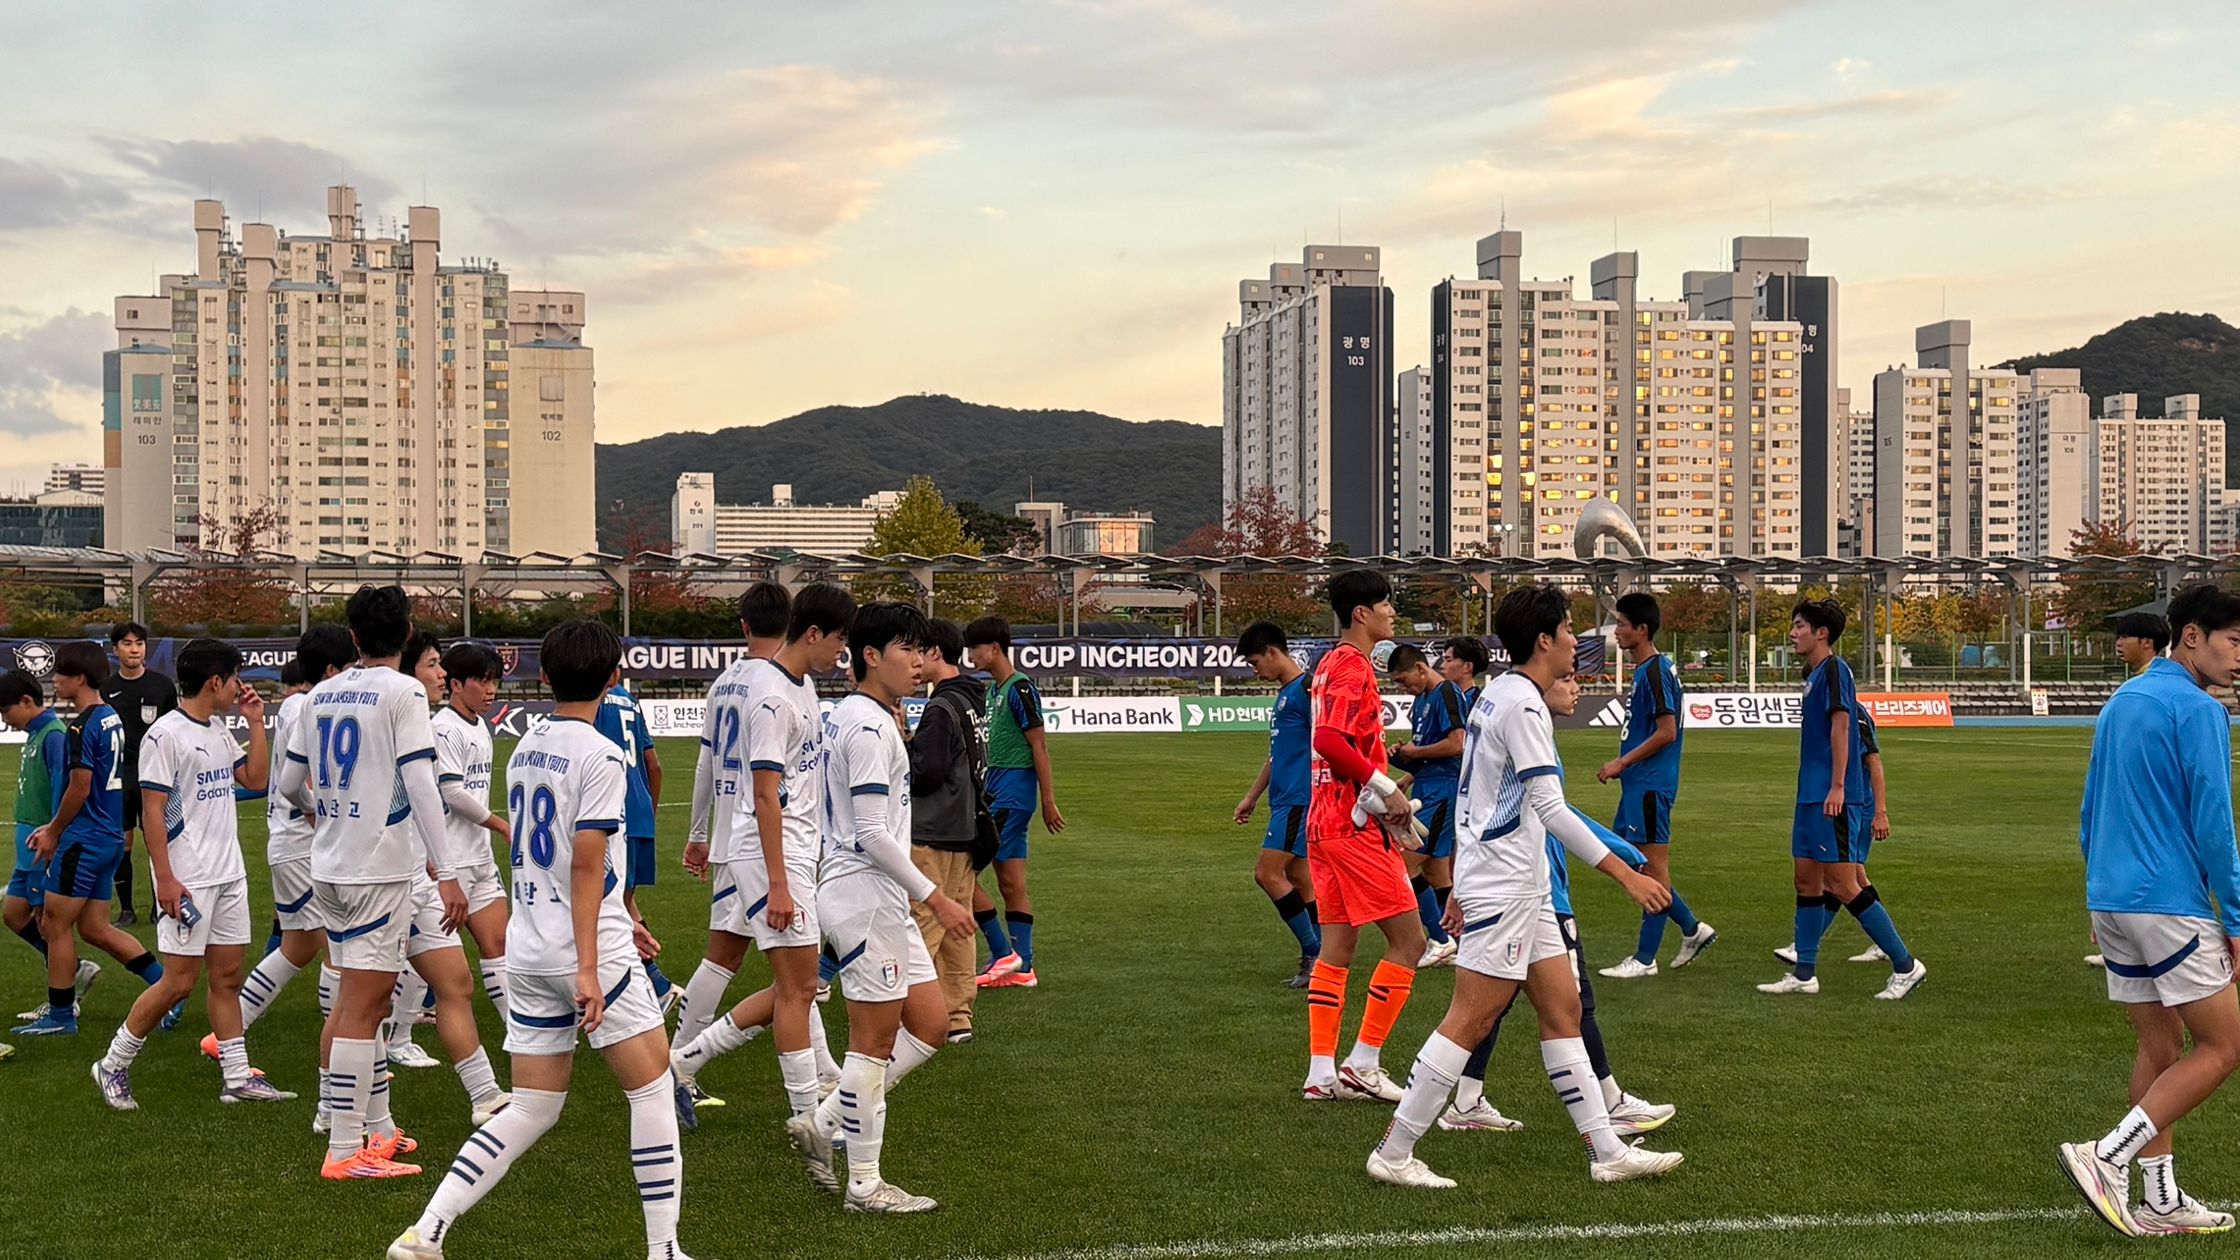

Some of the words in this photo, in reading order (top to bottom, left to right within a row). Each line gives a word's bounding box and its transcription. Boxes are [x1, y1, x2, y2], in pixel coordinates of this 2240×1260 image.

[1348, 356, 1365, 366] 103
[138, 435, 156, 445] 103
[542, 431, 561, 441] 102
[1020, 646, 1068, 668] CUP
[1080, 645, 1194, 668] INCHEON
[1203, 645, 1254, 668] 202
[1072, 708, 1122, 725] Hana
[1126, 708, 1174, 725] Bank
[1875, 701, 1948, 716] 브리즈케어
[316, 715, 361, 790] 19
[509, 781, 556, 871] 28
